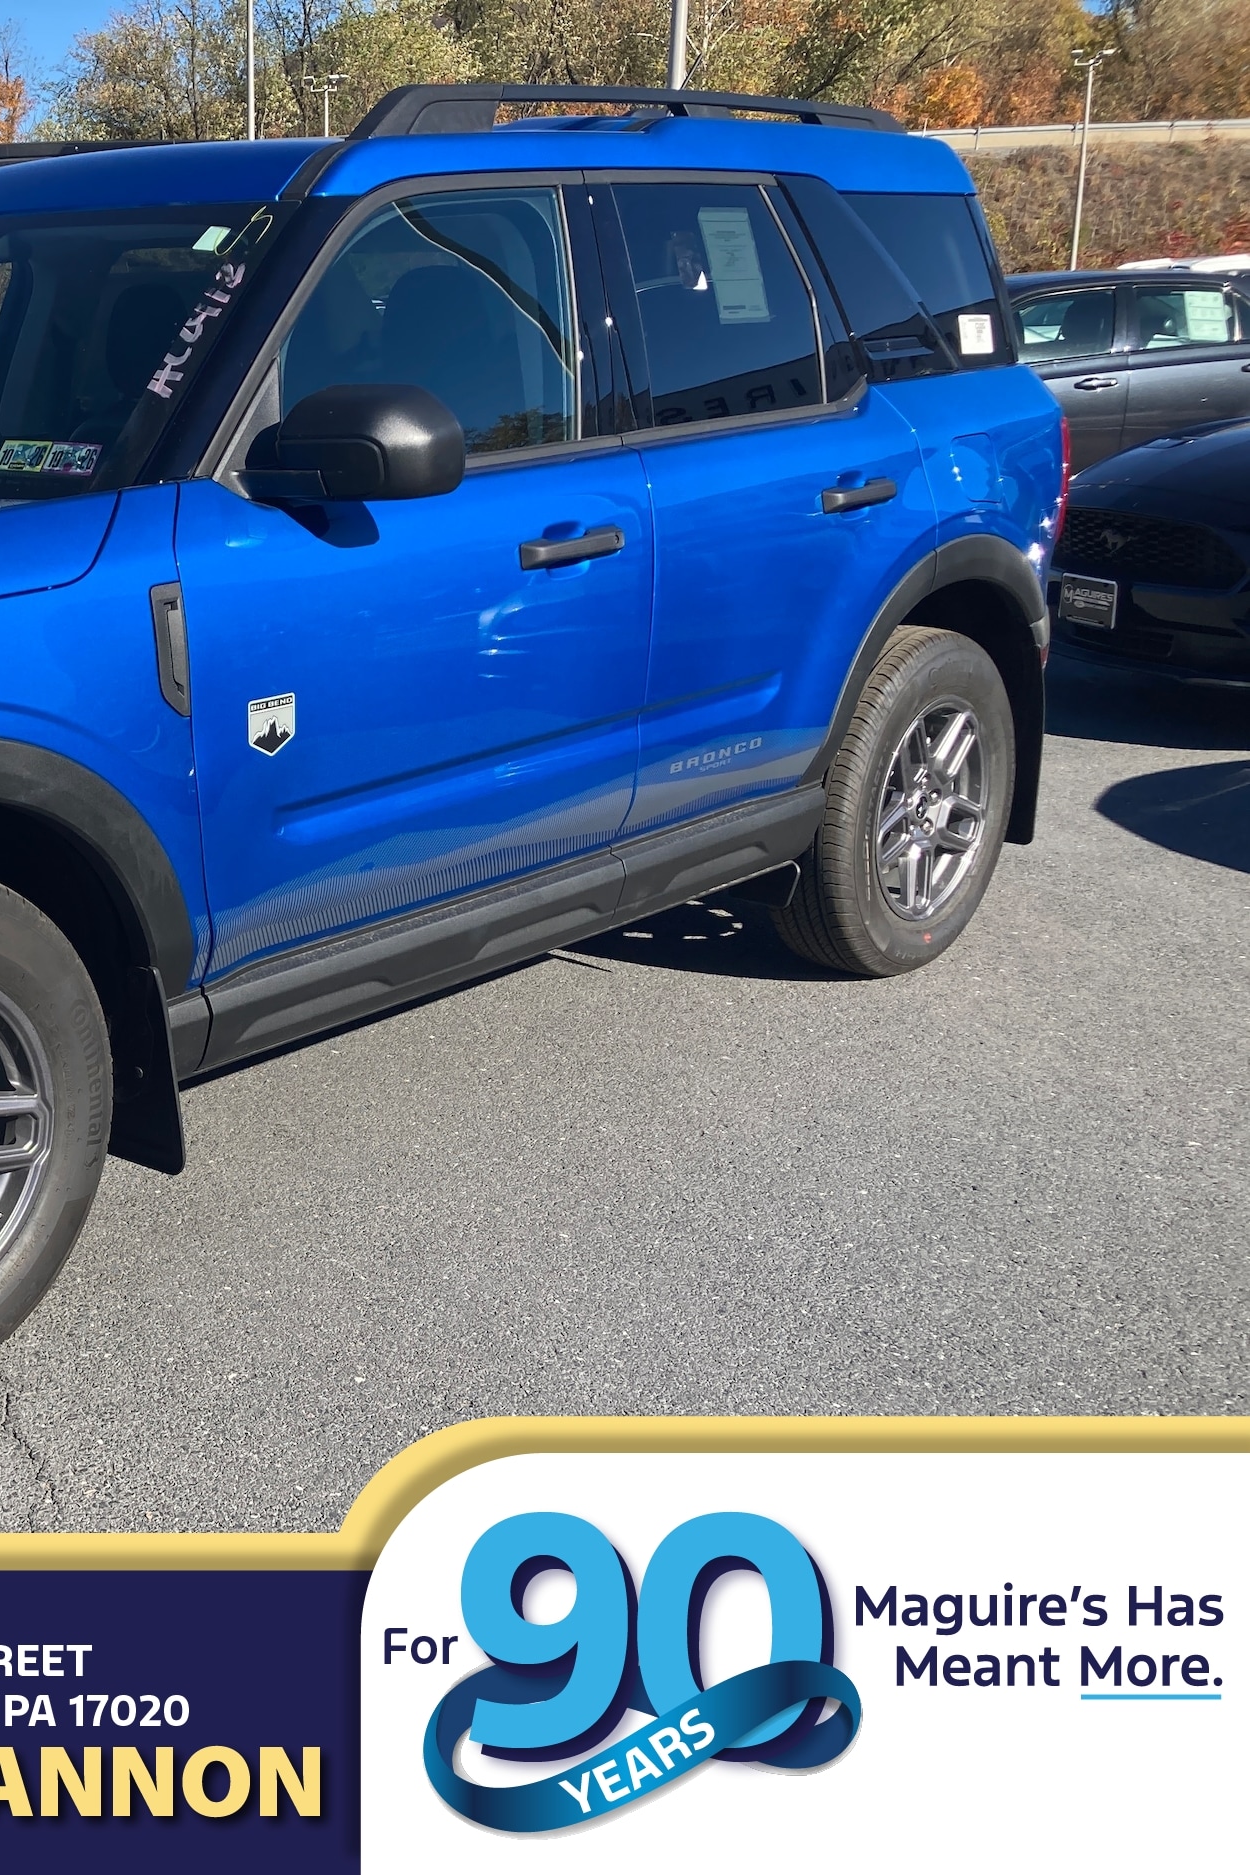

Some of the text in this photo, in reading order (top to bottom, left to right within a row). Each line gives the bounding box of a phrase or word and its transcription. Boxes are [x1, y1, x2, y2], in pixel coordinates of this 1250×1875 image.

[30, 446, 47, 467] 26
[48, 448, 97, 469] 10 26
[250, 697, 293, 712] BIG BEND
[670, 737, 762, 774] BRONCO
[699, 757, 732, 773] SPORT
